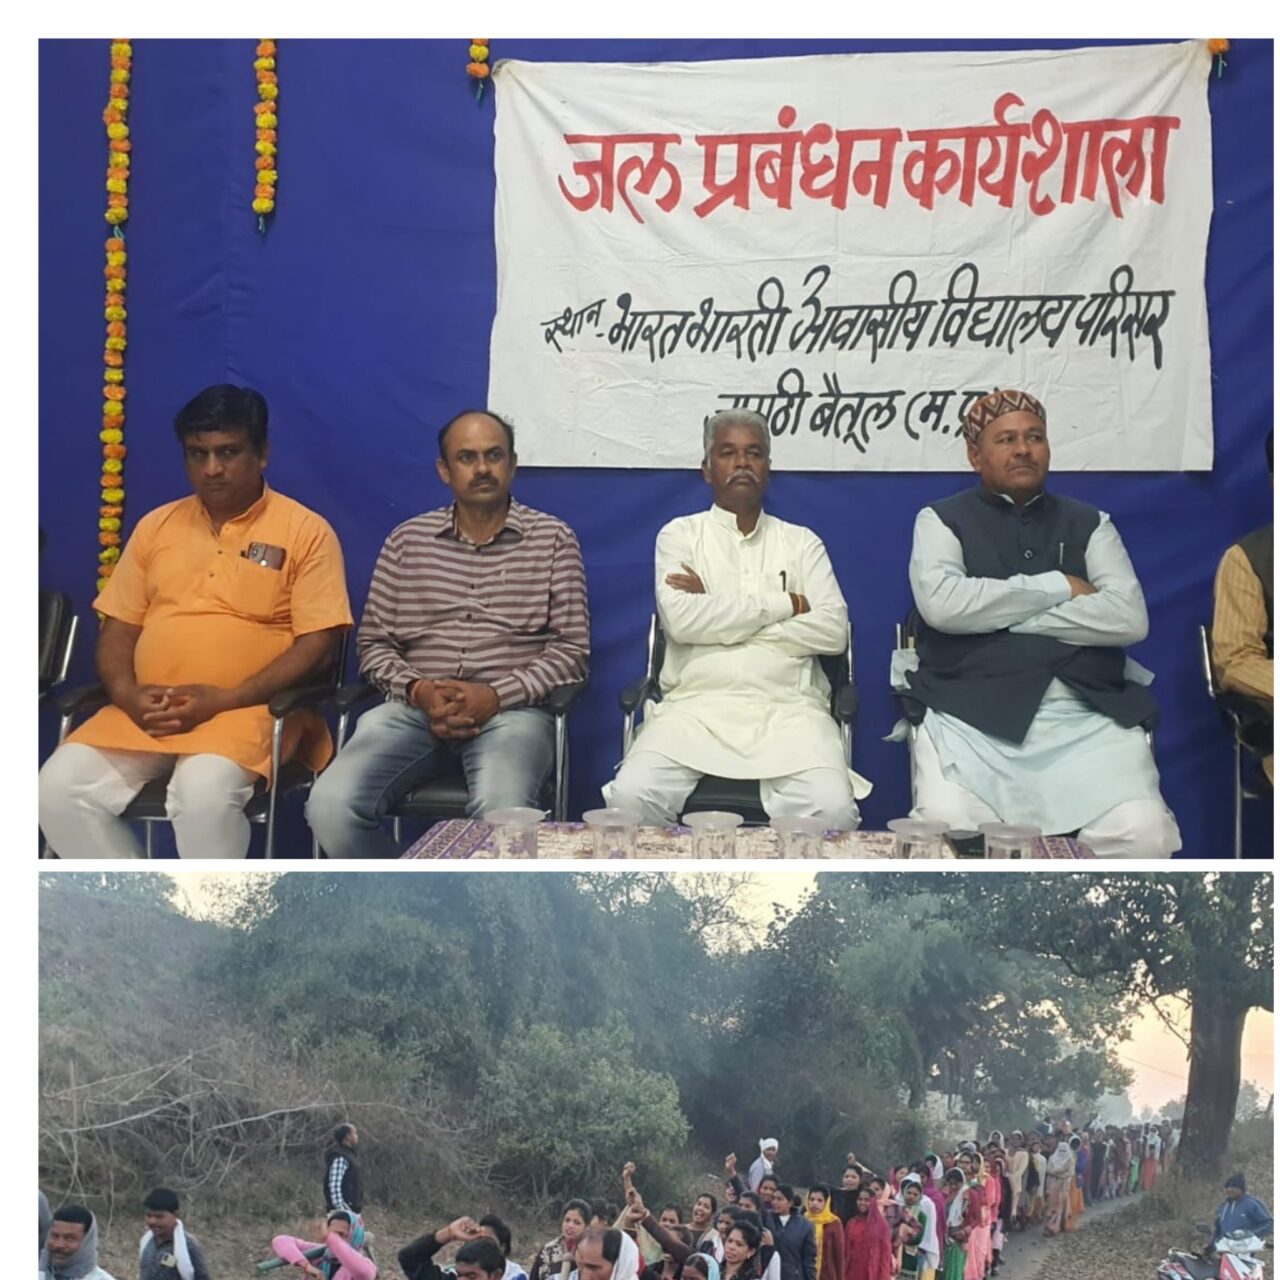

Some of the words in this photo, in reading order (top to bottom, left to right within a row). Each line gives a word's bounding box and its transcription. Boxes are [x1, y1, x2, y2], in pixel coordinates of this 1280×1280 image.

[558, 132, 682, 224] जल
[693, 104, 903, 219] प्रबंधन
[903, 91, 1181, 219] कार्यशाला
[608, 292, 697, 363] भारत
[686, 277, 792, 363] भारती
[789, 264, 938, 363] आवासीय
[929, 262, 1087, 355] विद्यालय
[1076, 264, 1177, 370] परिसर
[809, 371, 906, 454] बैतूल
